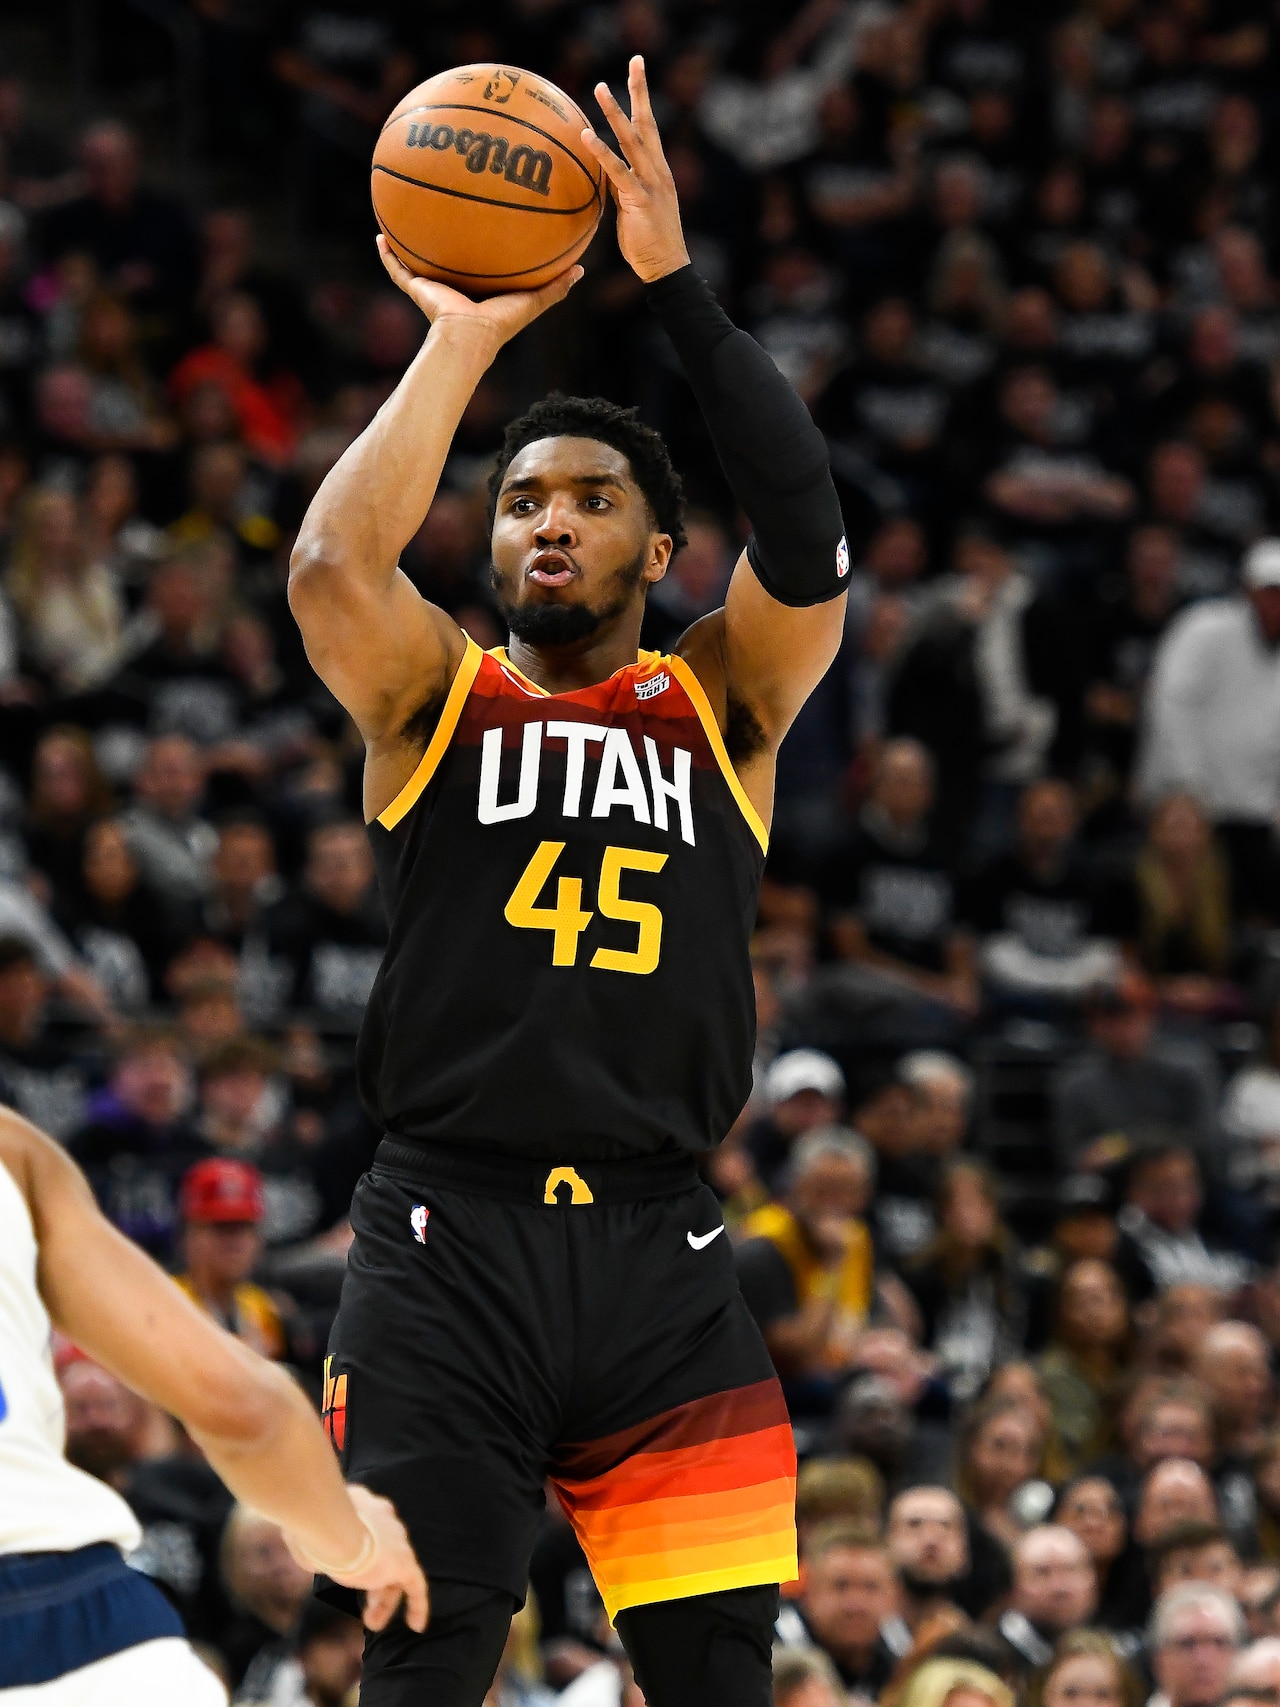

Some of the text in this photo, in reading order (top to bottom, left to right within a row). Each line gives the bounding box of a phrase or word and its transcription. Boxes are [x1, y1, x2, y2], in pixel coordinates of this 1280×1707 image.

[405, 121, 553, 196] Wilson
[478, 720, 696, 847] UTAH
[503, 840, 670, 975] 45
